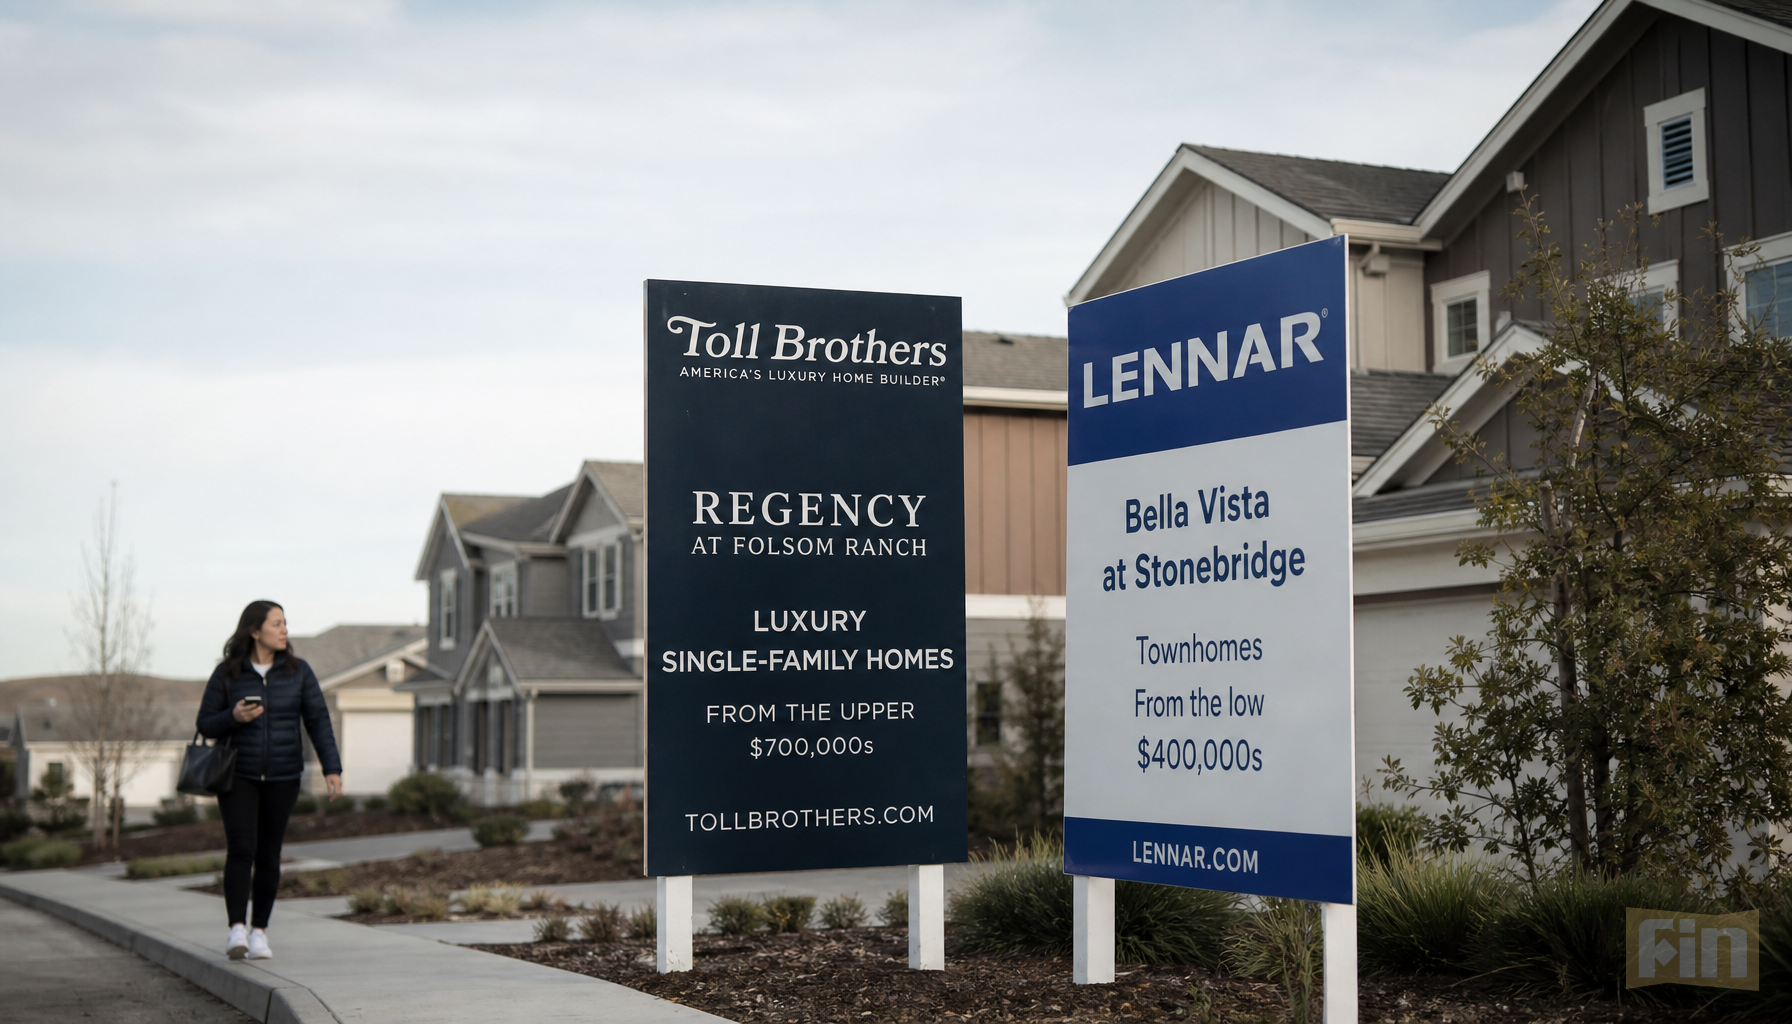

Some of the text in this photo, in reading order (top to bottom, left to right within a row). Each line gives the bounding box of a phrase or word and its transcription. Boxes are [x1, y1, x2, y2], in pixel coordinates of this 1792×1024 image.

[667, 315, 947, 367] Toll Brothers
[679, 366, 762, 380] AMERICA'S
[769, 369, 826, 382] LUXURY
[833, 372, 874, 384] HOME
[692, 490, 926, 527] REGENCY
[1125, 485, 1269, 534] Bella Vista
[691, 536, 927, 556] AT FOLSOM RANCH
[1102, 540, 1305, 592] at Stonebridge
[753, 610, 867, 632] LUXURY
[661, 648, 955, 673] SINGLE-FAMILY HOMES
[1135, 632, 1263, 665] Townhomes
[706, 701, 915, 724] FROM THE UPPER
[1135, 685, 1265, 718] From the low
[750, 736, 874, 759] $700,000s
[1137, 735, 1263, 776] $400,000s
[685, 805, 934, 832] TOLLBROTHERS.COM
[1132, 840, 1259, 874] LENNAR.COM
